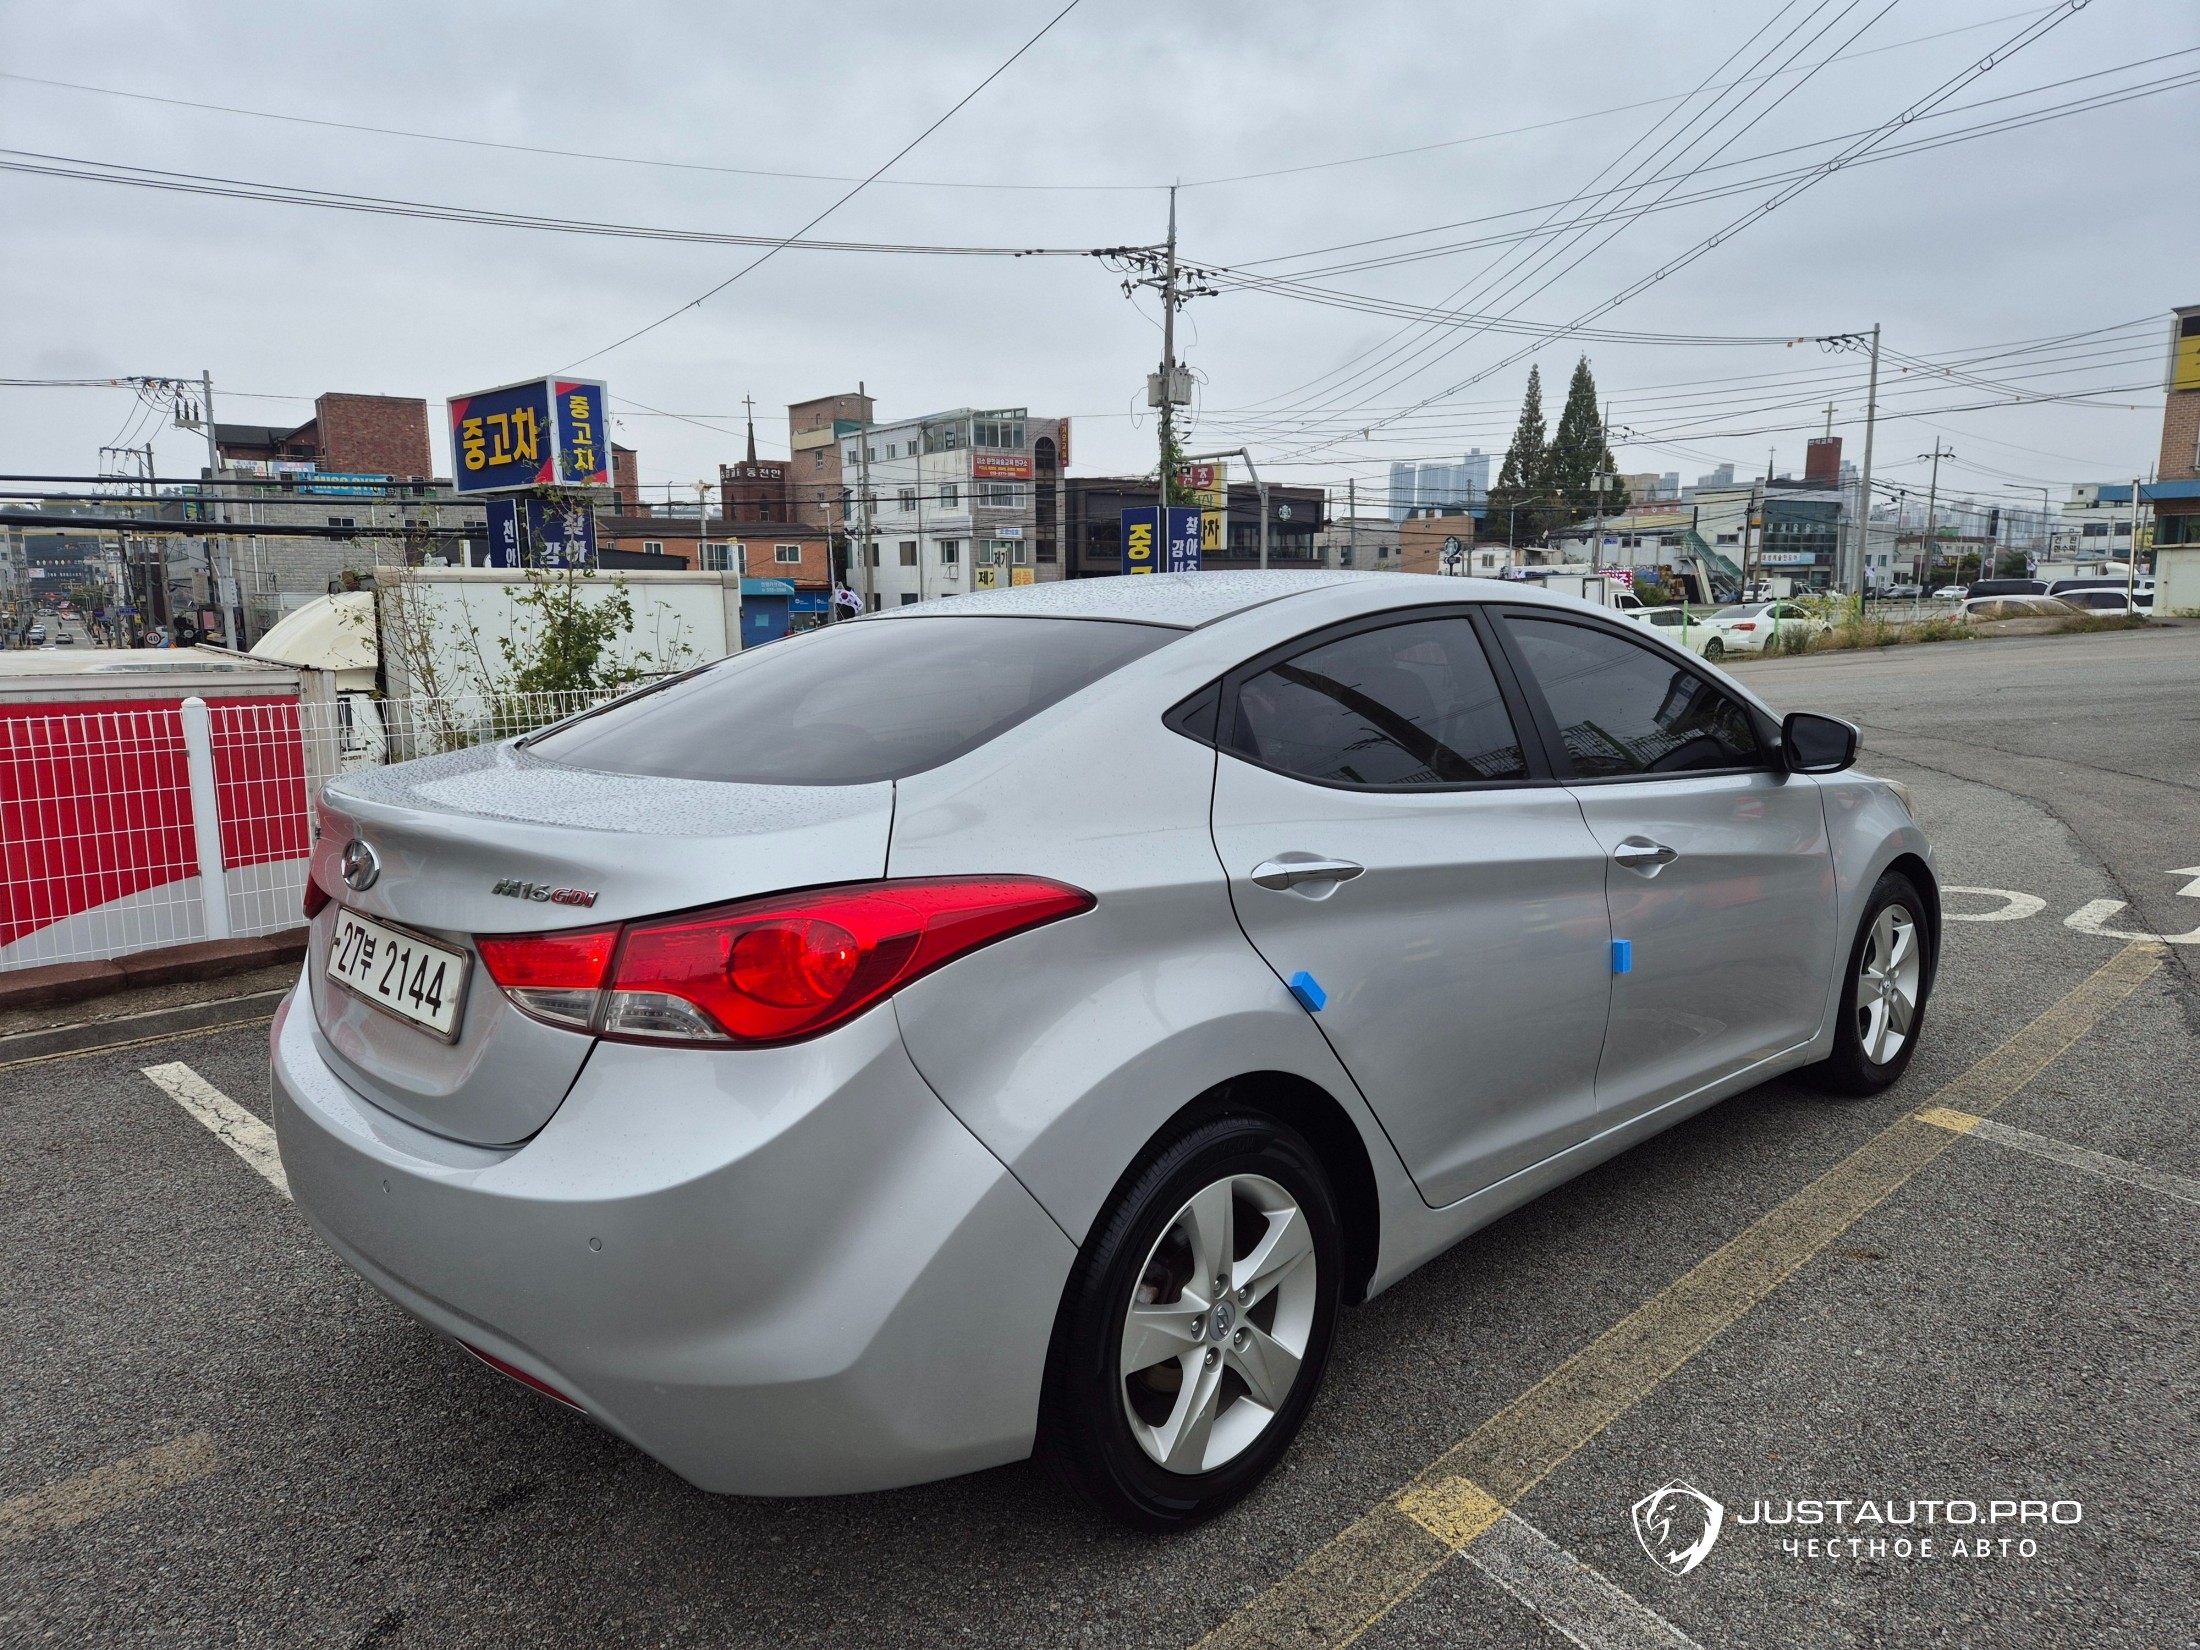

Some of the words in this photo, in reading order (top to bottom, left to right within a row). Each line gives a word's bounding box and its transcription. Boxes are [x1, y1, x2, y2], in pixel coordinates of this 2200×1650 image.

[462, 407, 539, 471] 중고차
[569, 395, 595, 471] 중고차
[147, 634, 159, 643] 40
[337, 921, 378, 981] 27부
[378, 940, 447, 1018] 2144
